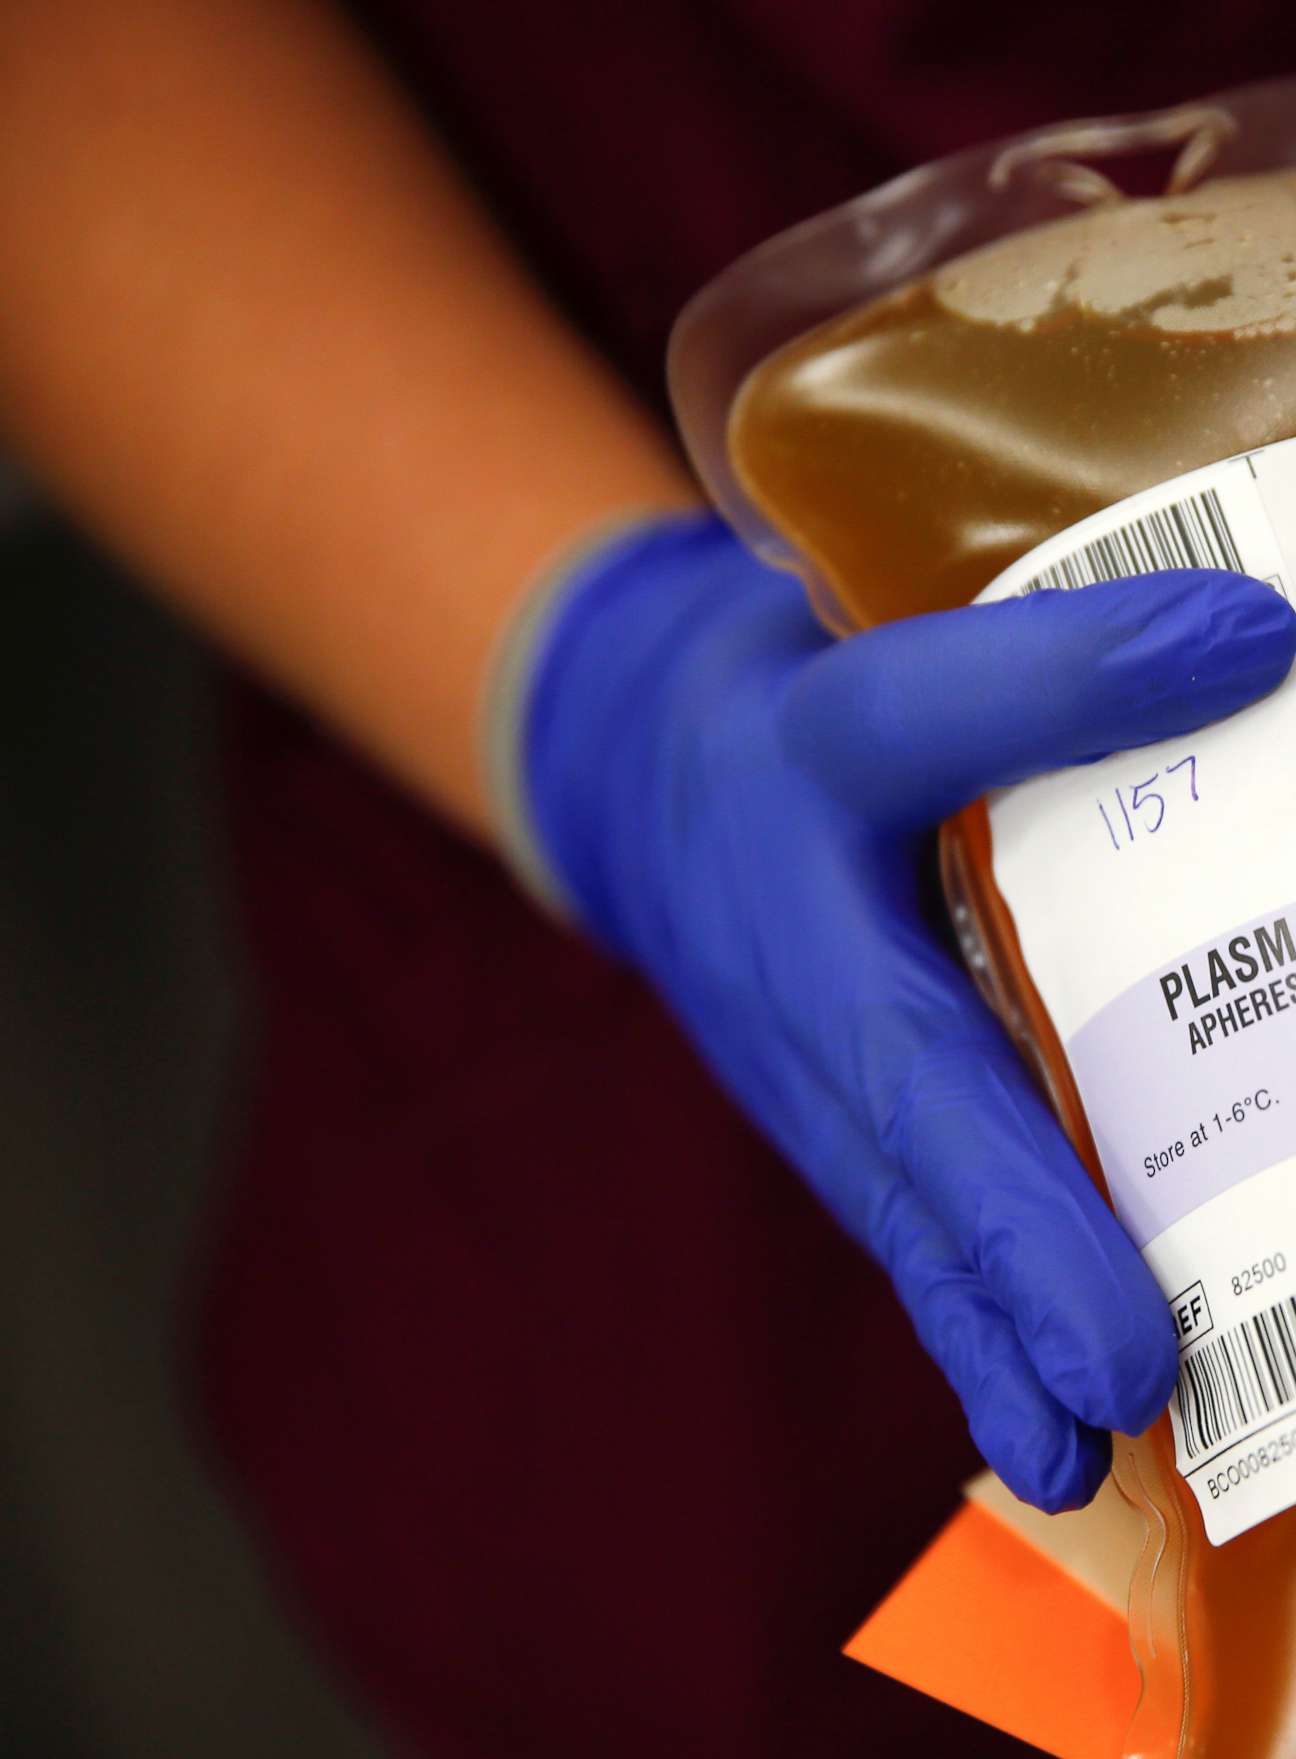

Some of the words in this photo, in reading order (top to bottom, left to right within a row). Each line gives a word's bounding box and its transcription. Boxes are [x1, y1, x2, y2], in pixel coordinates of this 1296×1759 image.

[1097, 755, 1199, 850] 1157
[1143, 1141, 1185, 1178] Store
[1190, 1122, 1209, 1148] at
[1212, 1088, 1280, 1133] 1-6°C.
[1231, 1252, 1287, 1296] 82500
[1172, 1295, 1202, 1340] EF
